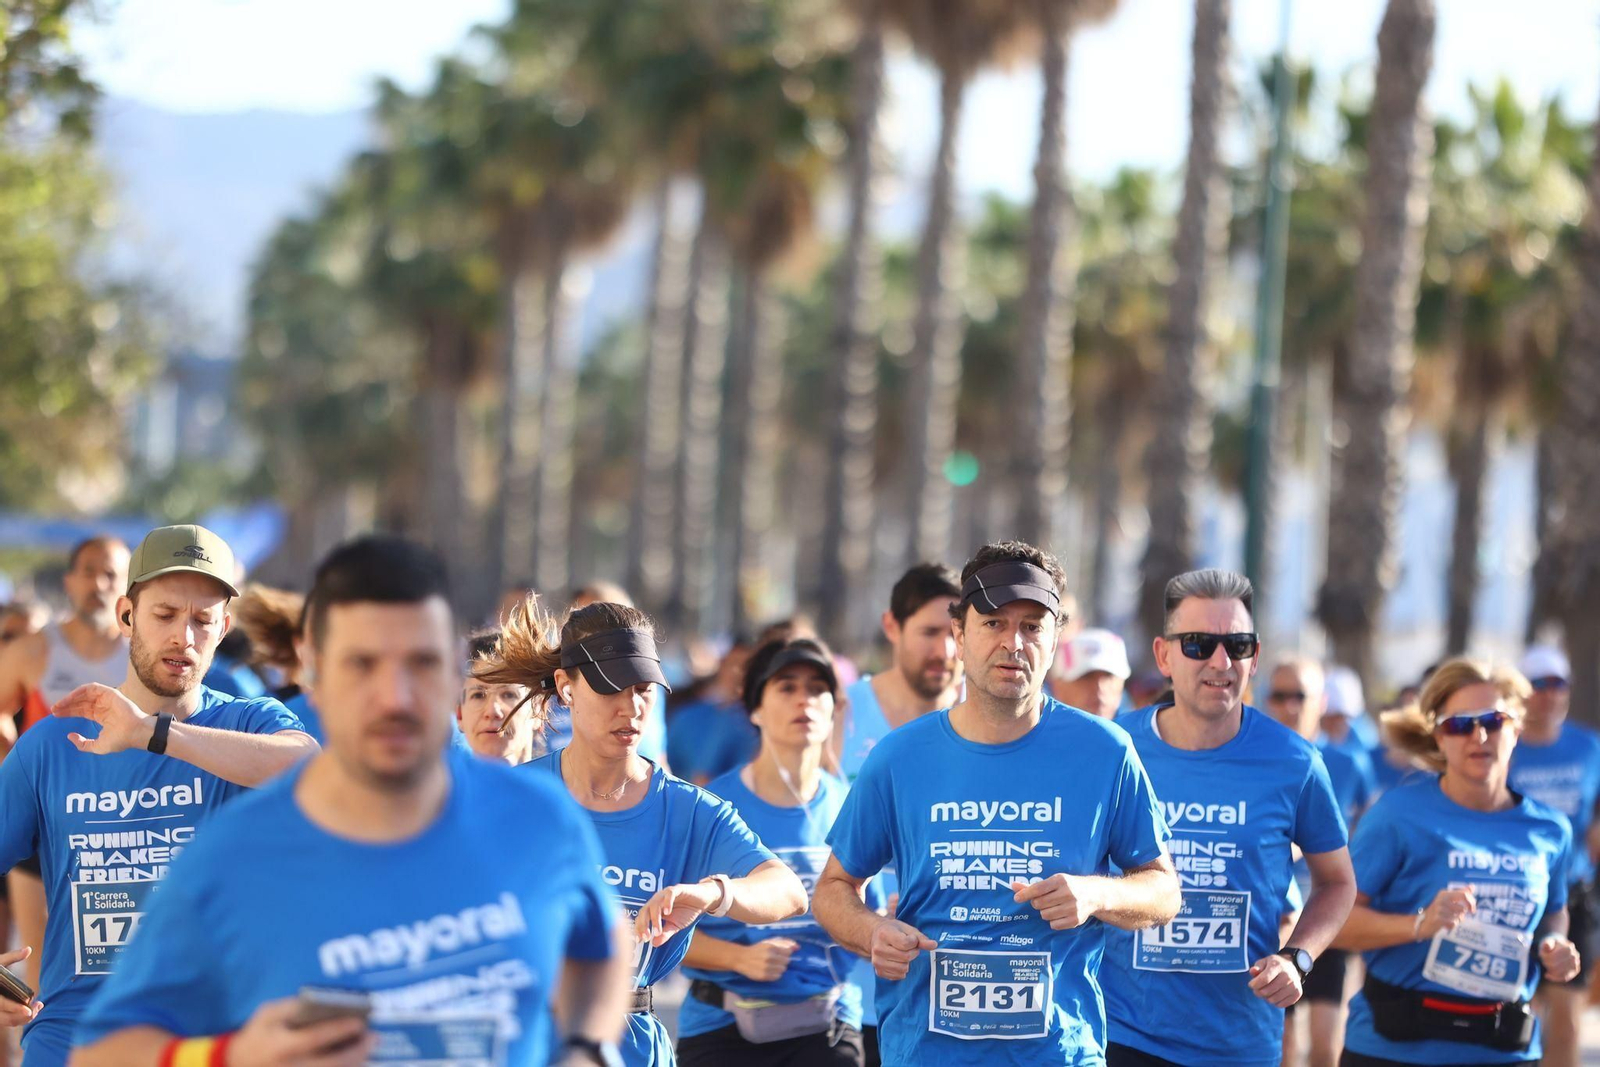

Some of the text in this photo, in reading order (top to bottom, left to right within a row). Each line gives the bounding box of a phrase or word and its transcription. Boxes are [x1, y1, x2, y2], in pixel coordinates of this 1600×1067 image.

[66, 777, 203, 818] mayoral
[930, 796, 1062, 828] mayoral
[1158, 800, 1247, 828] yoral
[68, 826, 196, 850] RUNNING
[930, 840, 1054, 858] RUNNING
[941, 858, 1043, 875] MAKES
[1175, 856, 1227, 874] KES
[601, 865, 665, 893] oral
[94, 891, 128, 900] Carrera
[94, 898, 136, 909] Solidaria
[1207, 895, 1244, 904] mayoral
[969, 914, 1012, 922] INFANTILES
[970, 907, 1001, 915] ALDEAS
[90, 916, 144, 943] 17
[318, 891, 527, 978] mayoral
[1151, 921, 1233, 944] 1574
[1000, 933, 1034, 946] málaga
[85, 947, 106, 955] 10KM
[1141, 945, 1162, 953] 10KM
[952, 960, 987, 970] Carrera
[1009, 957, 1045, 968] mayoral
[1453, 945, 1508, 979] 736
[952, 969, 993, 979] Solidaria
[945, 983, 1034, 1009] 2131
[939, 1009, 960, 1018] 10KM
